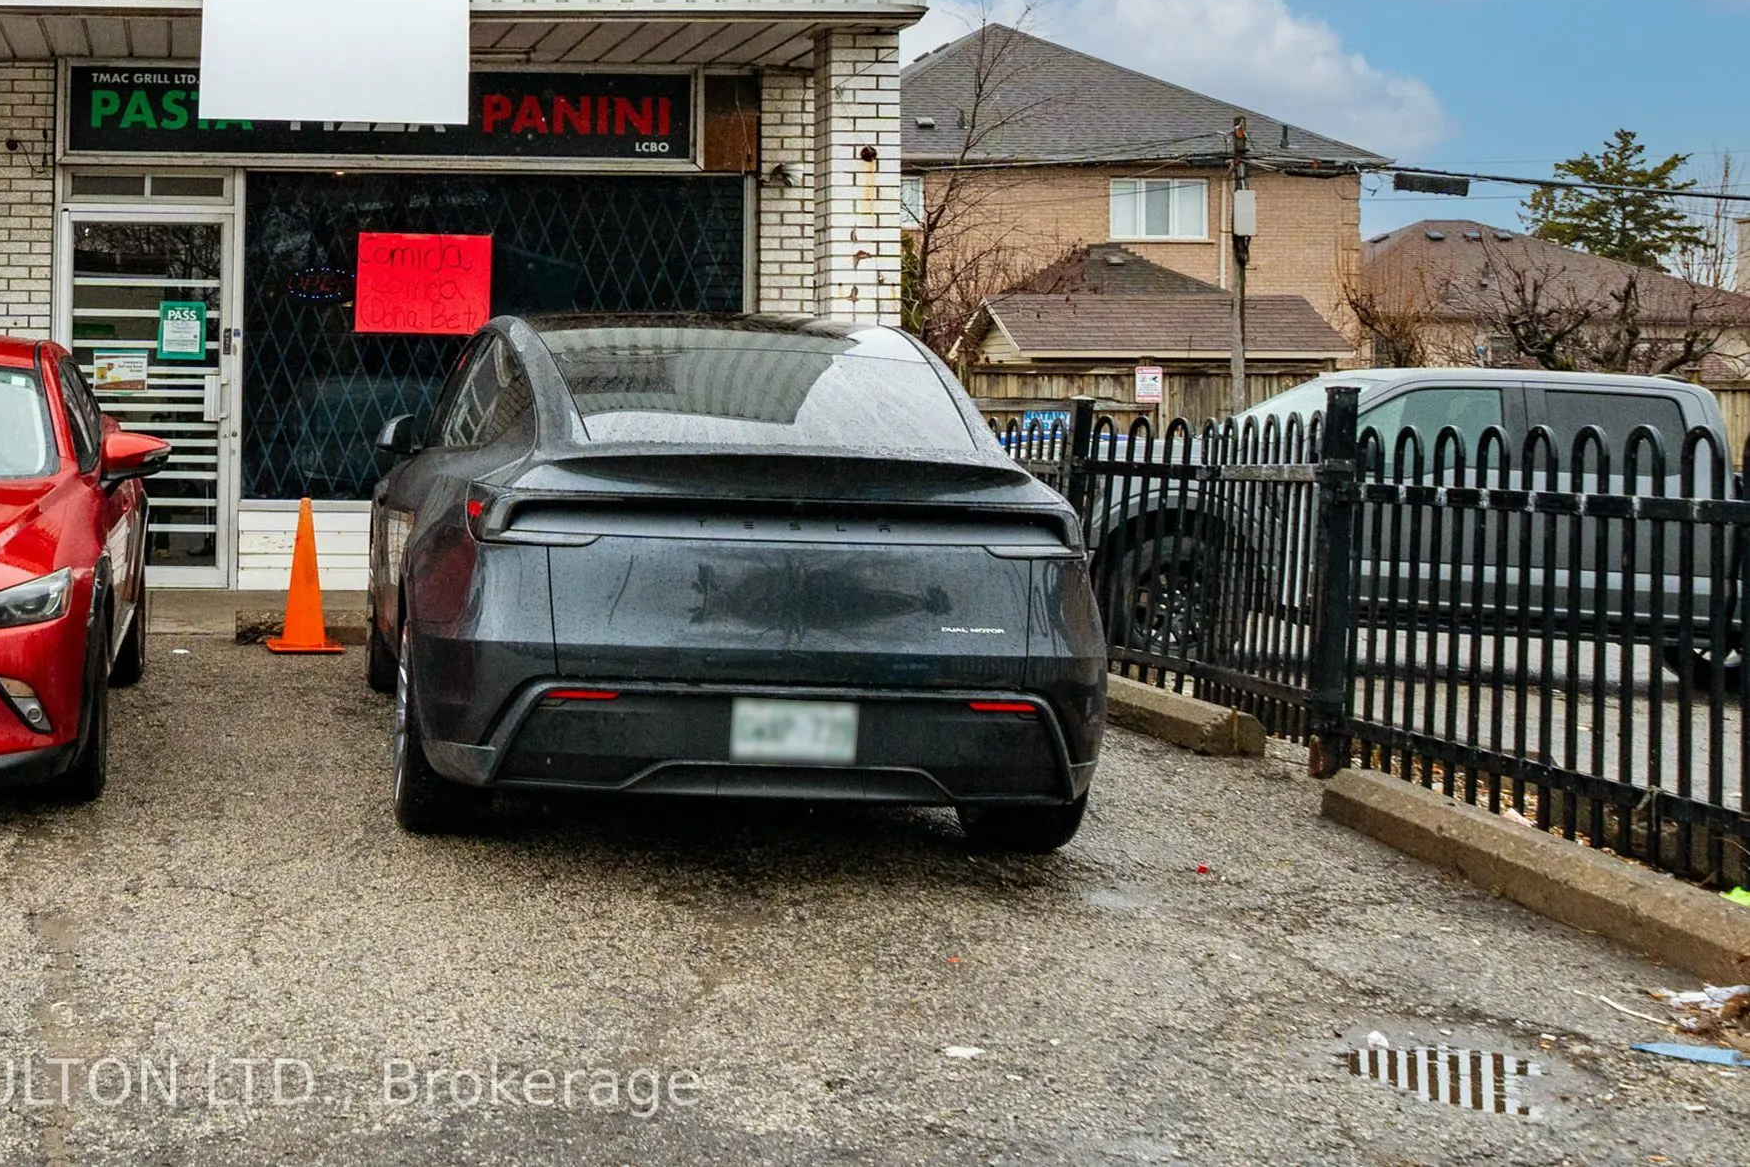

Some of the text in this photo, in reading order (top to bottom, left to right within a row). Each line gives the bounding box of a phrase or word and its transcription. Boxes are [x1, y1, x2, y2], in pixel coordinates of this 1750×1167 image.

[91, 73, 200, 85] TMAC GRILL LTD.
[482, 94, 671, 135] PANINI
[635, 141, 669, 152] LCBO
[359, 235, 474, 272] Comida
[167, 309, 198, 321] PASS
[697, 518, 892, 534] TESLA
[940, 626, 1006, 635] DUAL MOTOR
